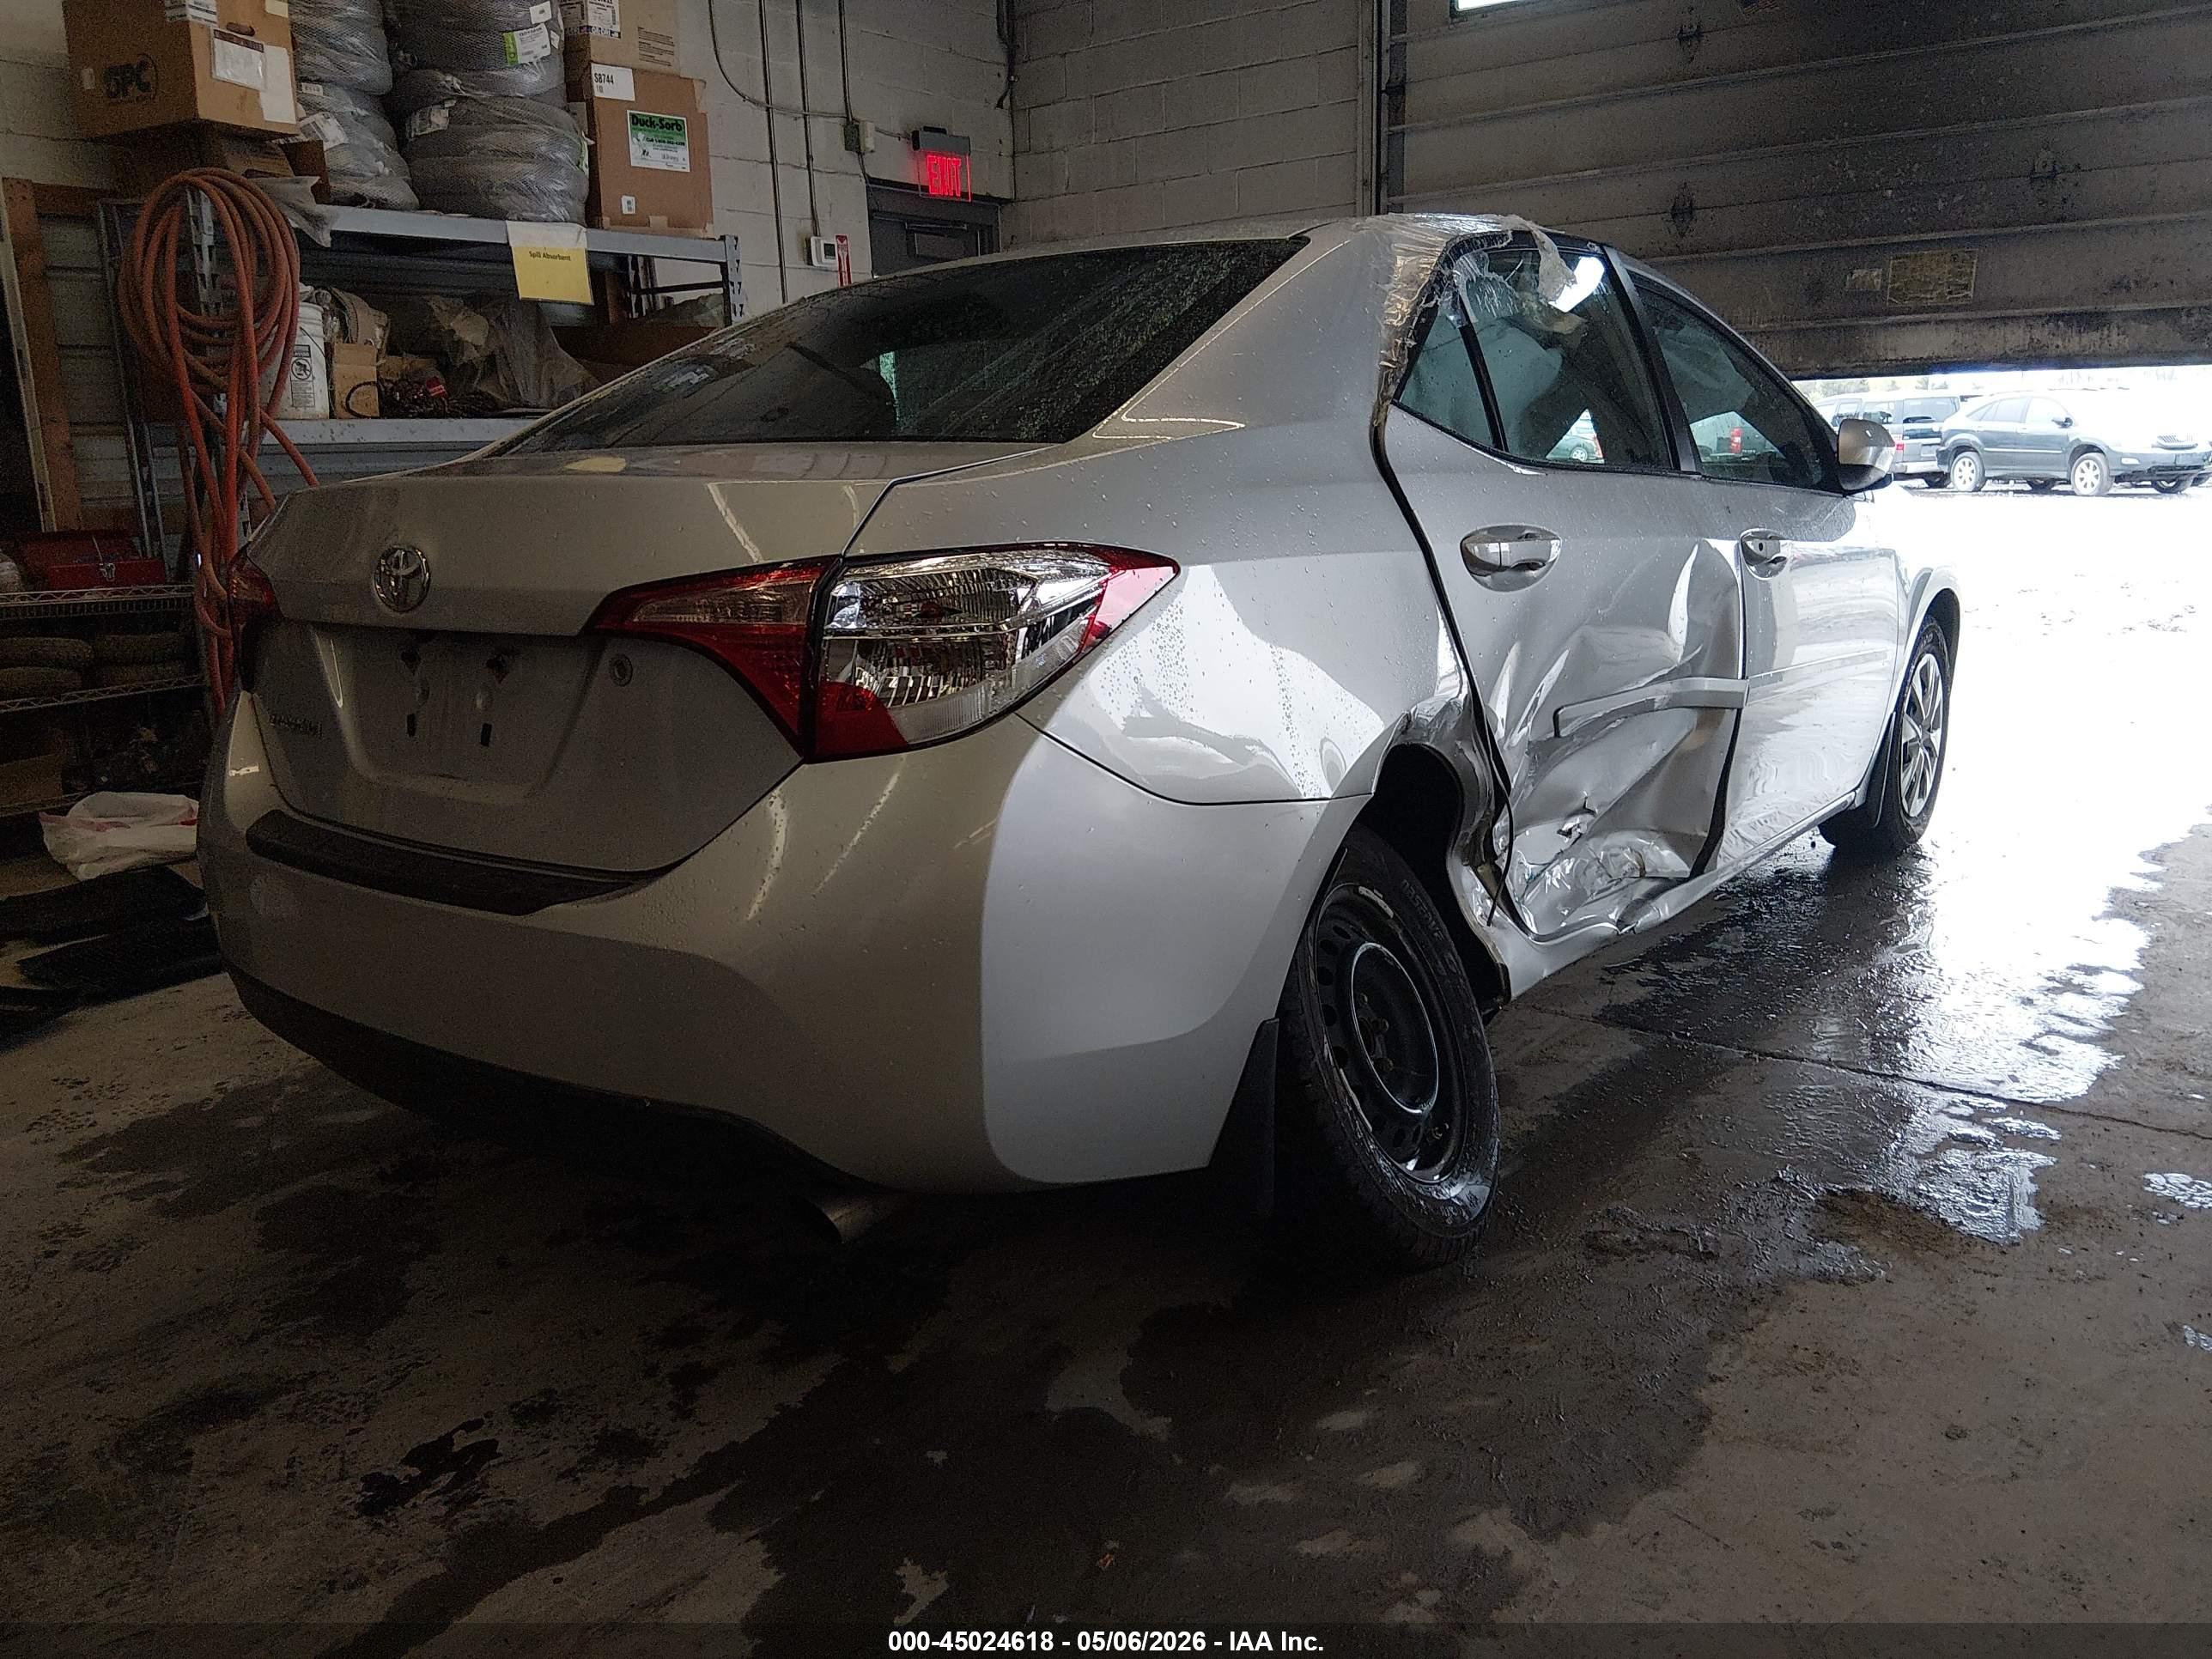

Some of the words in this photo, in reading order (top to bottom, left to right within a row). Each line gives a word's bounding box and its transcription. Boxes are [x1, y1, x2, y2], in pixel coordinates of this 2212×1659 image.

[631, 114, 683, 131] Duck-Sorb
[927, 155, 962, 198] EXIT
[528, 251, 541, 259] Spill
[542, 252, 571, 261] Absorbent
